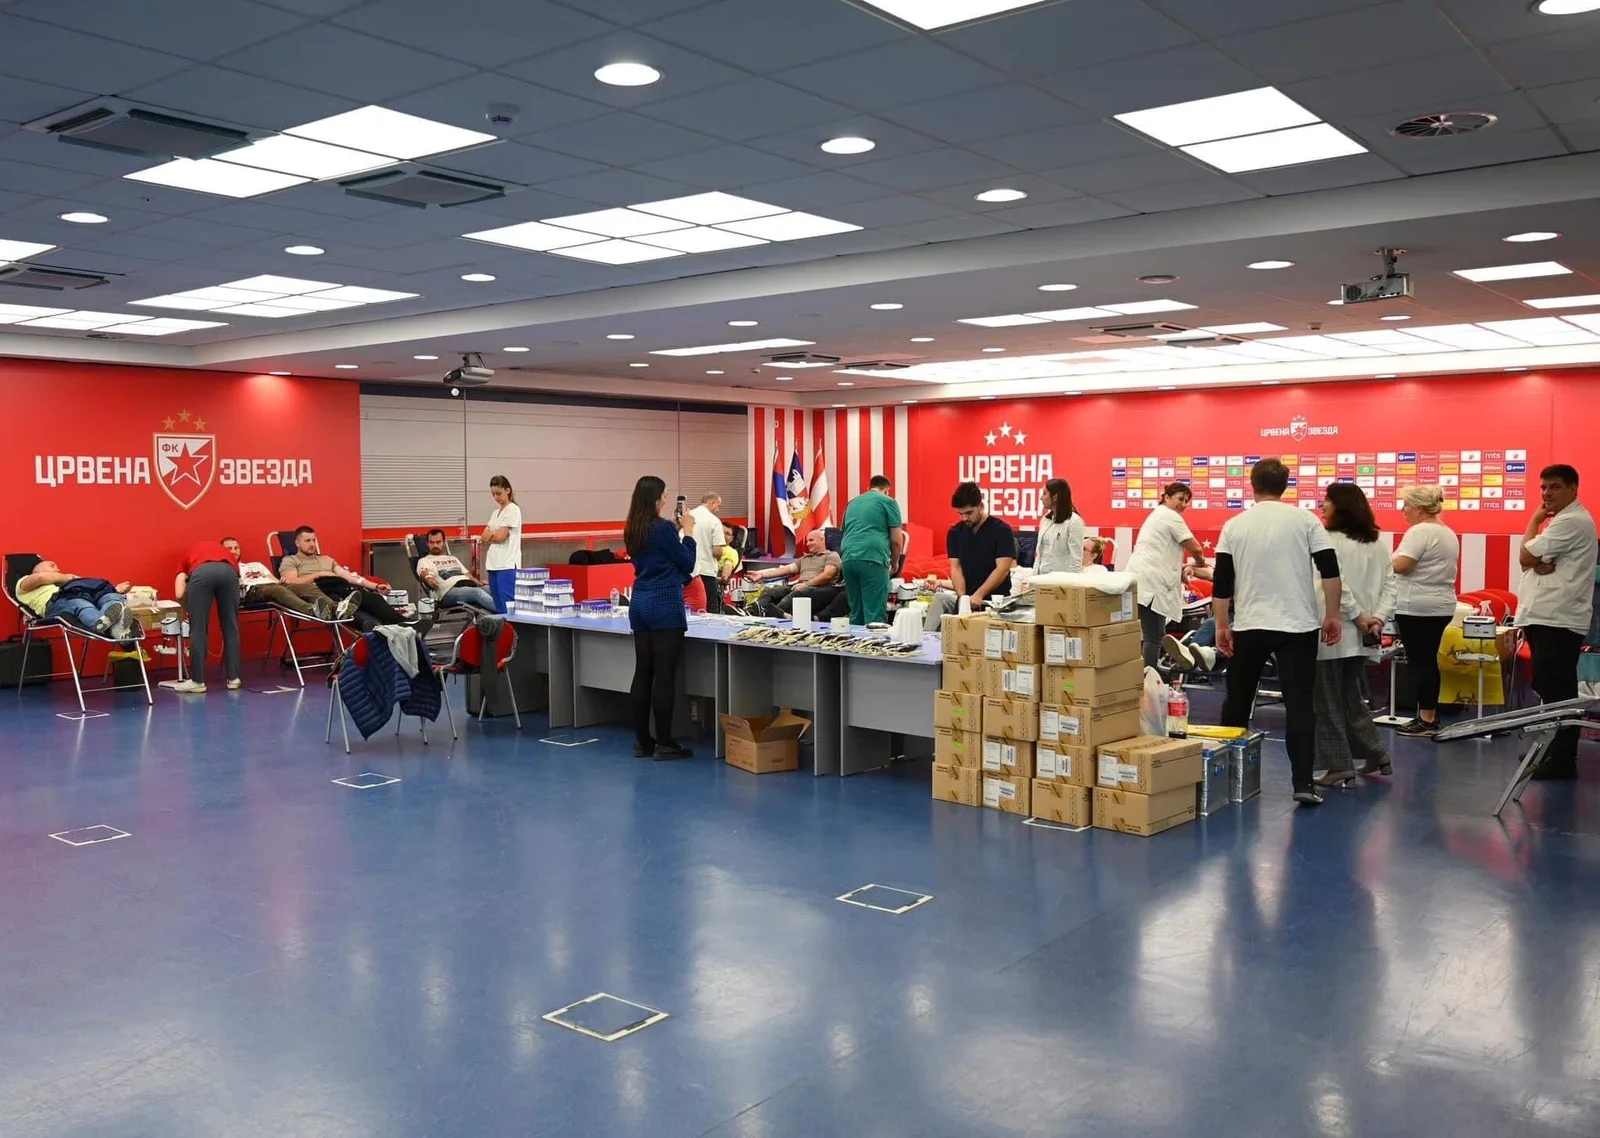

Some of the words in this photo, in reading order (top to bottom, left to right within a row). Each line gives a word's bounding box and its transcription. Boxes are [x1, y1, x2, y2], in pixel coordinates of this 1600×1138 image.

[162, 443, 178, 452] ФК
[34, 455, 151, 487] ЦРВЕНА
[220, 458, 312, 487] ЗВЕЗДА
[958, 454, 1052, 482] ЦРВЕНА
[981, 488, 1044, 519] ВЕЗД
